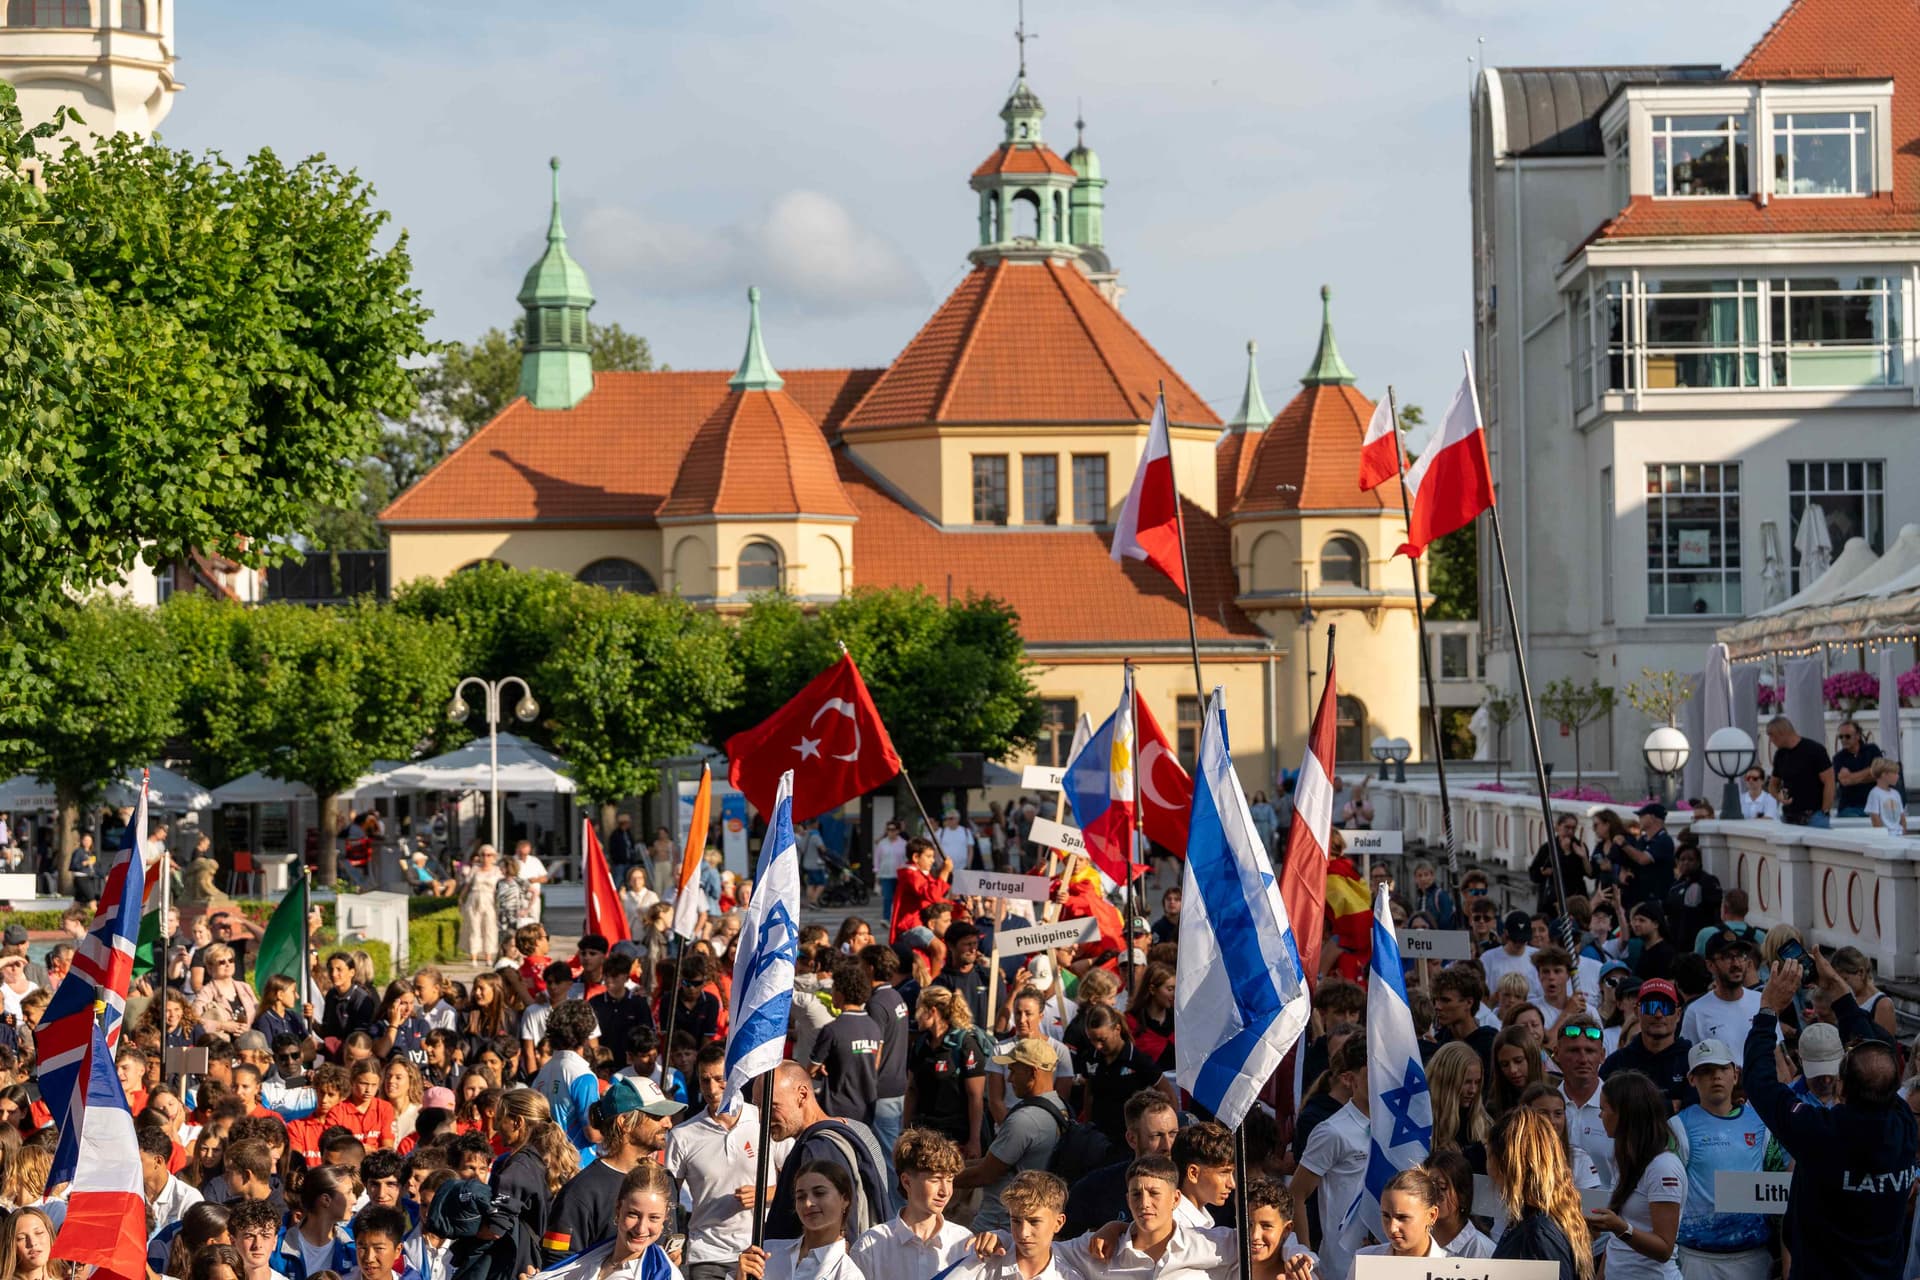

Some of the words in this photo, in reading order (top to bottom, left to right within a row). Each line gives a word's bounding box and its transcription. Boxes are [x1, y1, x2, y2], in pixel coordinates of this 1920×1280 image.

[1050, 774, 1062, 784] Tu
[1061, 833, 1086, 849] Spai
[1354, 837, 1382, 848] Poland
[978, 878, 1025, 894] Portugal
[1015, 928, 1080, 947] Philippines
[1407, 938, 1433, 950] Peru
[1755, 1183, 1789, 1202] Lith
